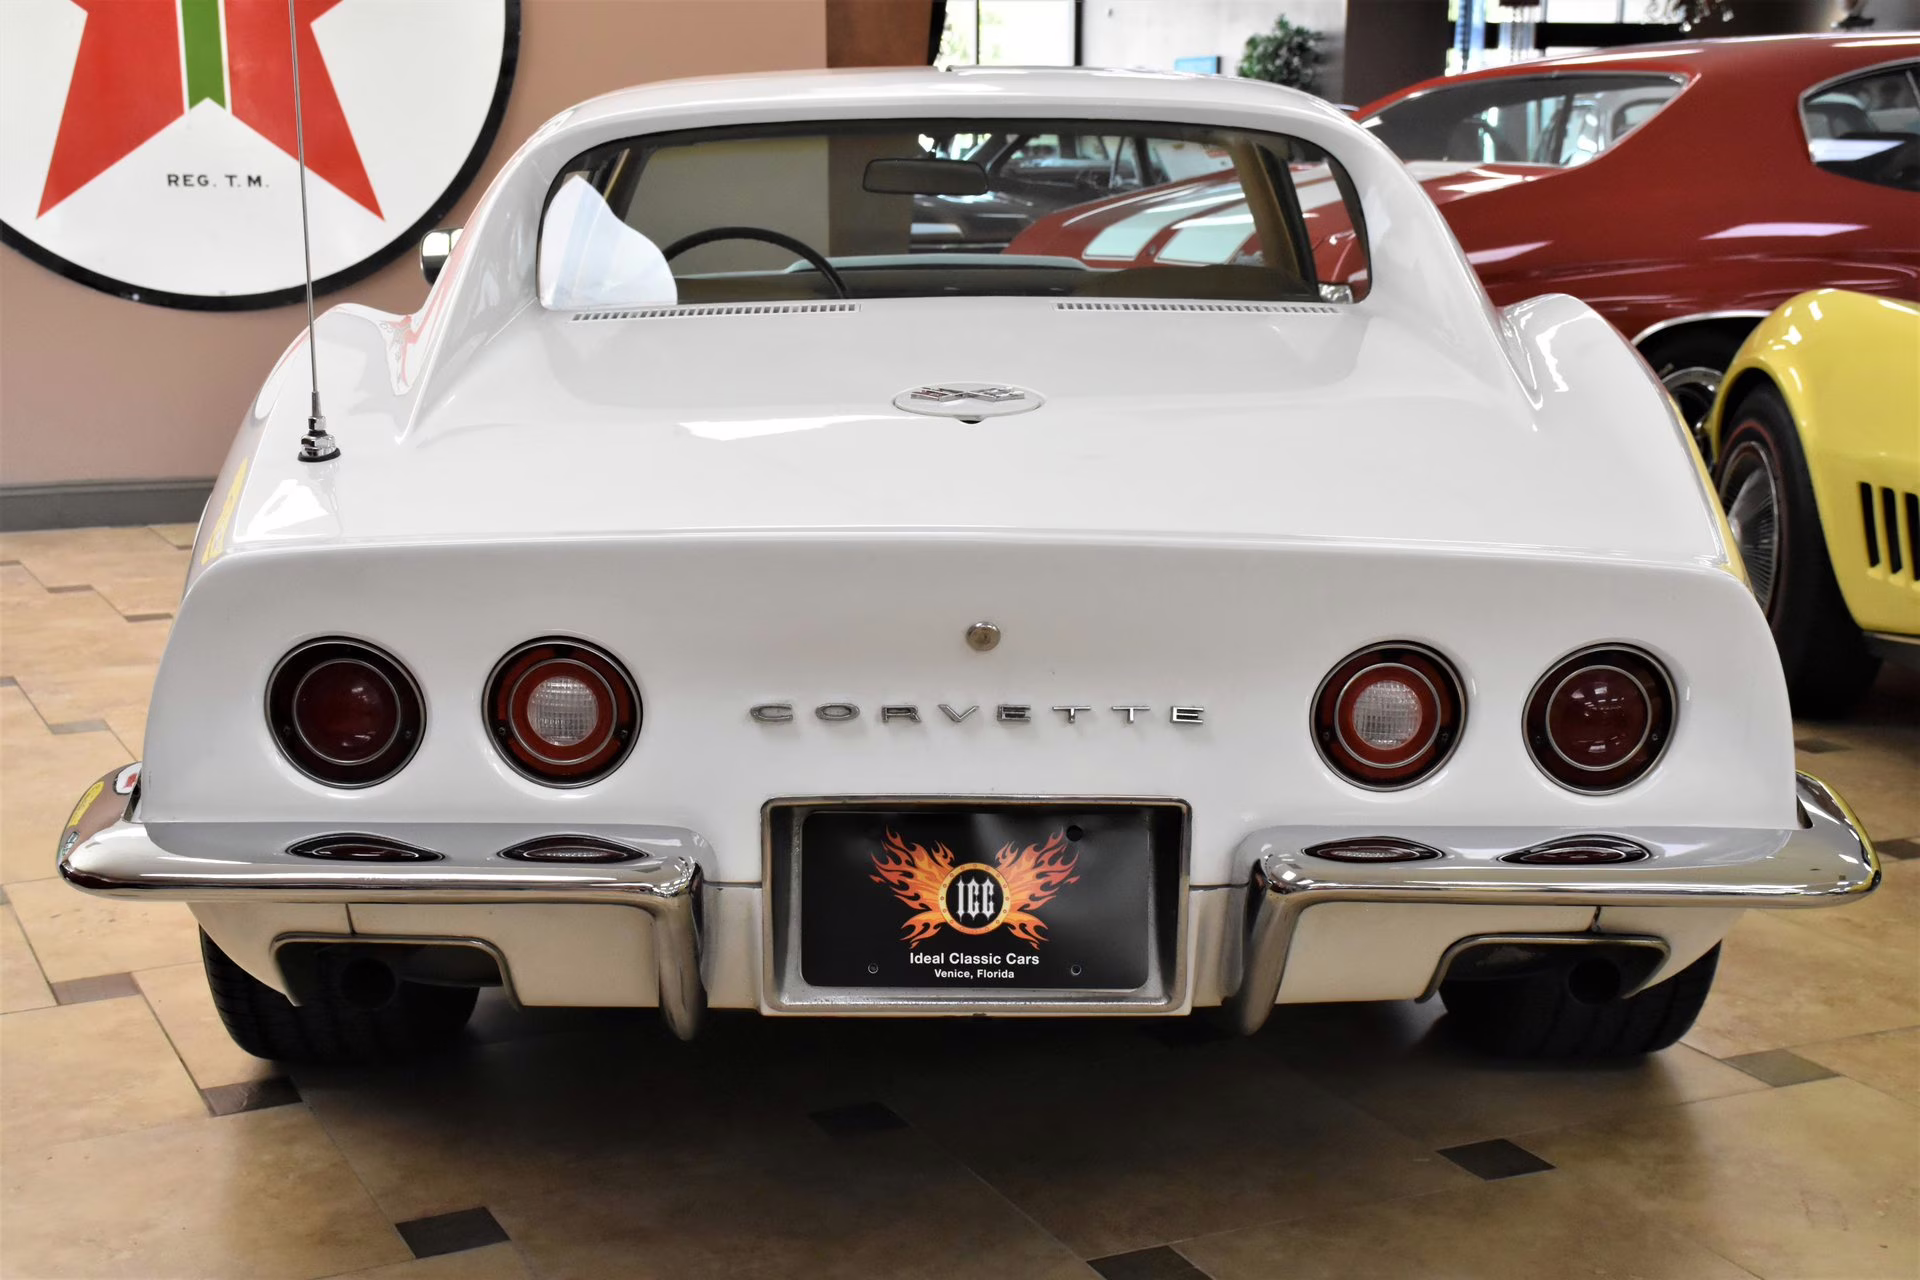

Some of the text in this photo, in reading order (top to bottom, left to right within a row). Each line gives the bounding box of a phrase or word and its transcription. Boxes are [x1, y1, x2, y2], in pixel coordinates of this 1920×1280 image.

[167, 174, 217, 187] REG.
[749, 702, 1206, 725] CORVETTE
[956, 876, 995, 922] ICC
[910, 952, 1040, 965] Ideal Classic Cars
[934, 969, 1015, 979] Venice, Florida
